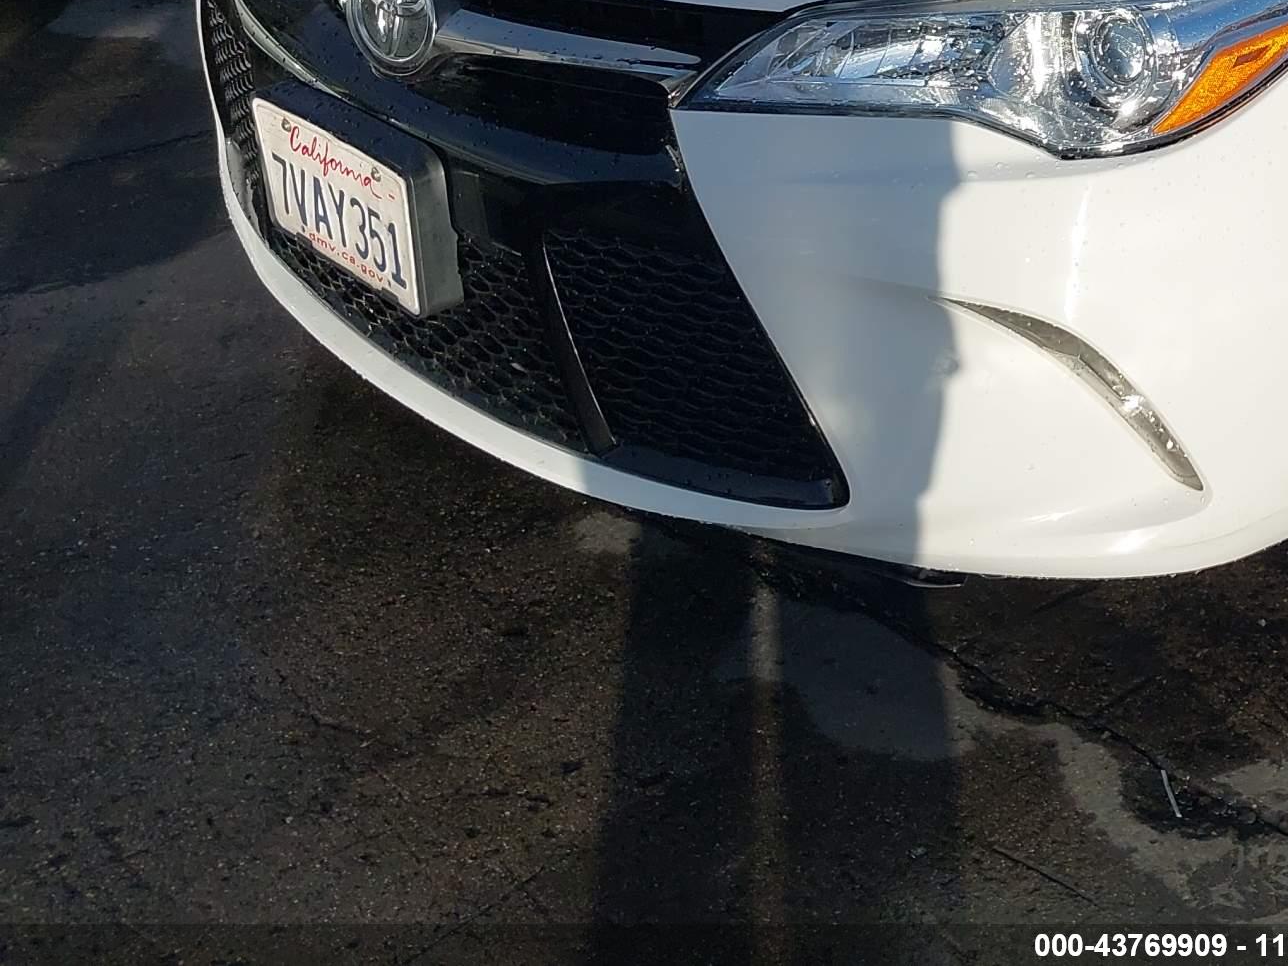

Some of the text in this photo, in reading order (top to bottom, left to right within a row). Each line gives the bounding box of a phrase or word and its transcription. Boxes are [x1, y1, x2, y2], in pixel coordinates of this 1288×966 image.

[290, 126, 382, 199] California
[272, 152, 407, 290] 7VAY351
[308, 232, 384, 283] dmv.ca.gov
